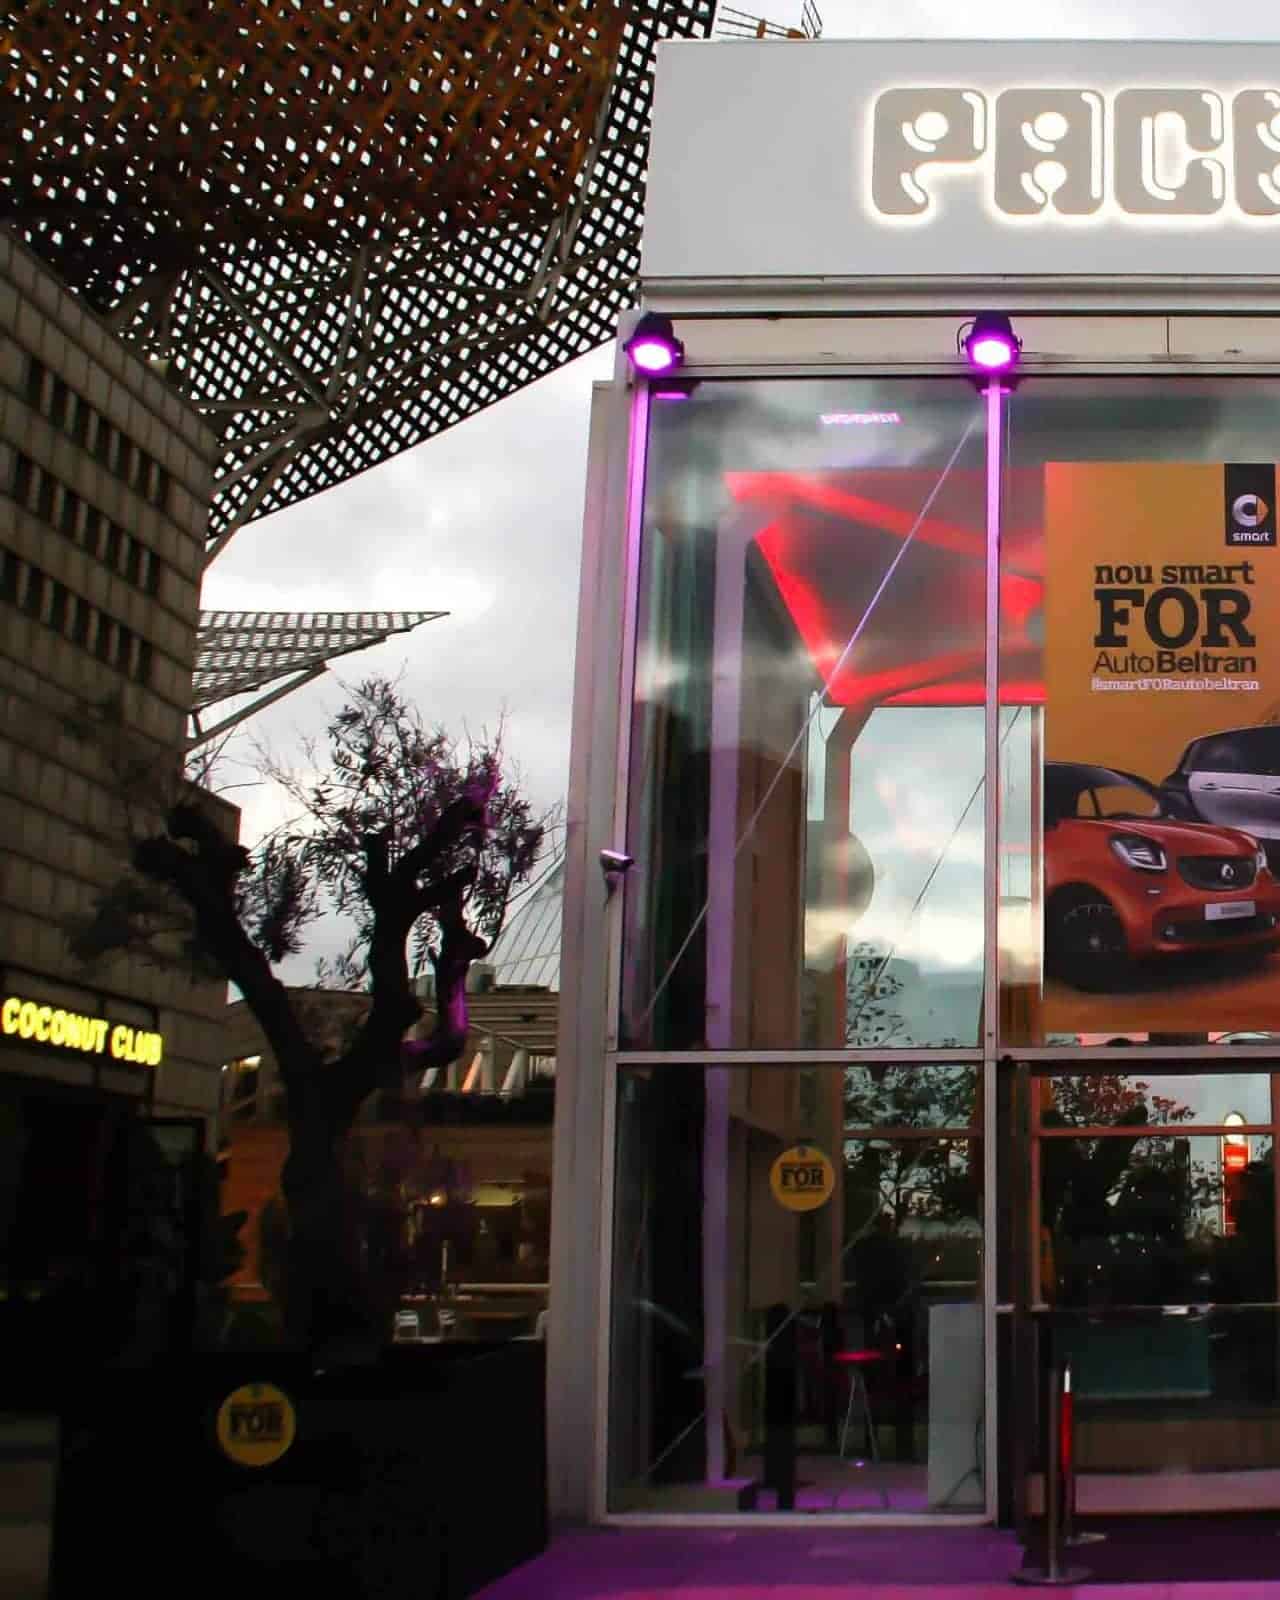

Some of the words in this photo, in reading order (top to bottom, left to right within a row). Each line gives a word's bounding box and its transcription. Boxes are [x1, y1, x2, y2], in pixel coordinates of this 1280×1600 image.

[1232, 531, 1271, 542] smart
[1094, 564, 1153, 585] nou
[1161, 561, 1255, 585] smart
[1094, 587, 1256, 649] FOR
[1093, 652, 1257, 674] AutoBeltran
[2, 998, 109, 1053] COCONUT
[781, 1167, 825, 1187] FOR
